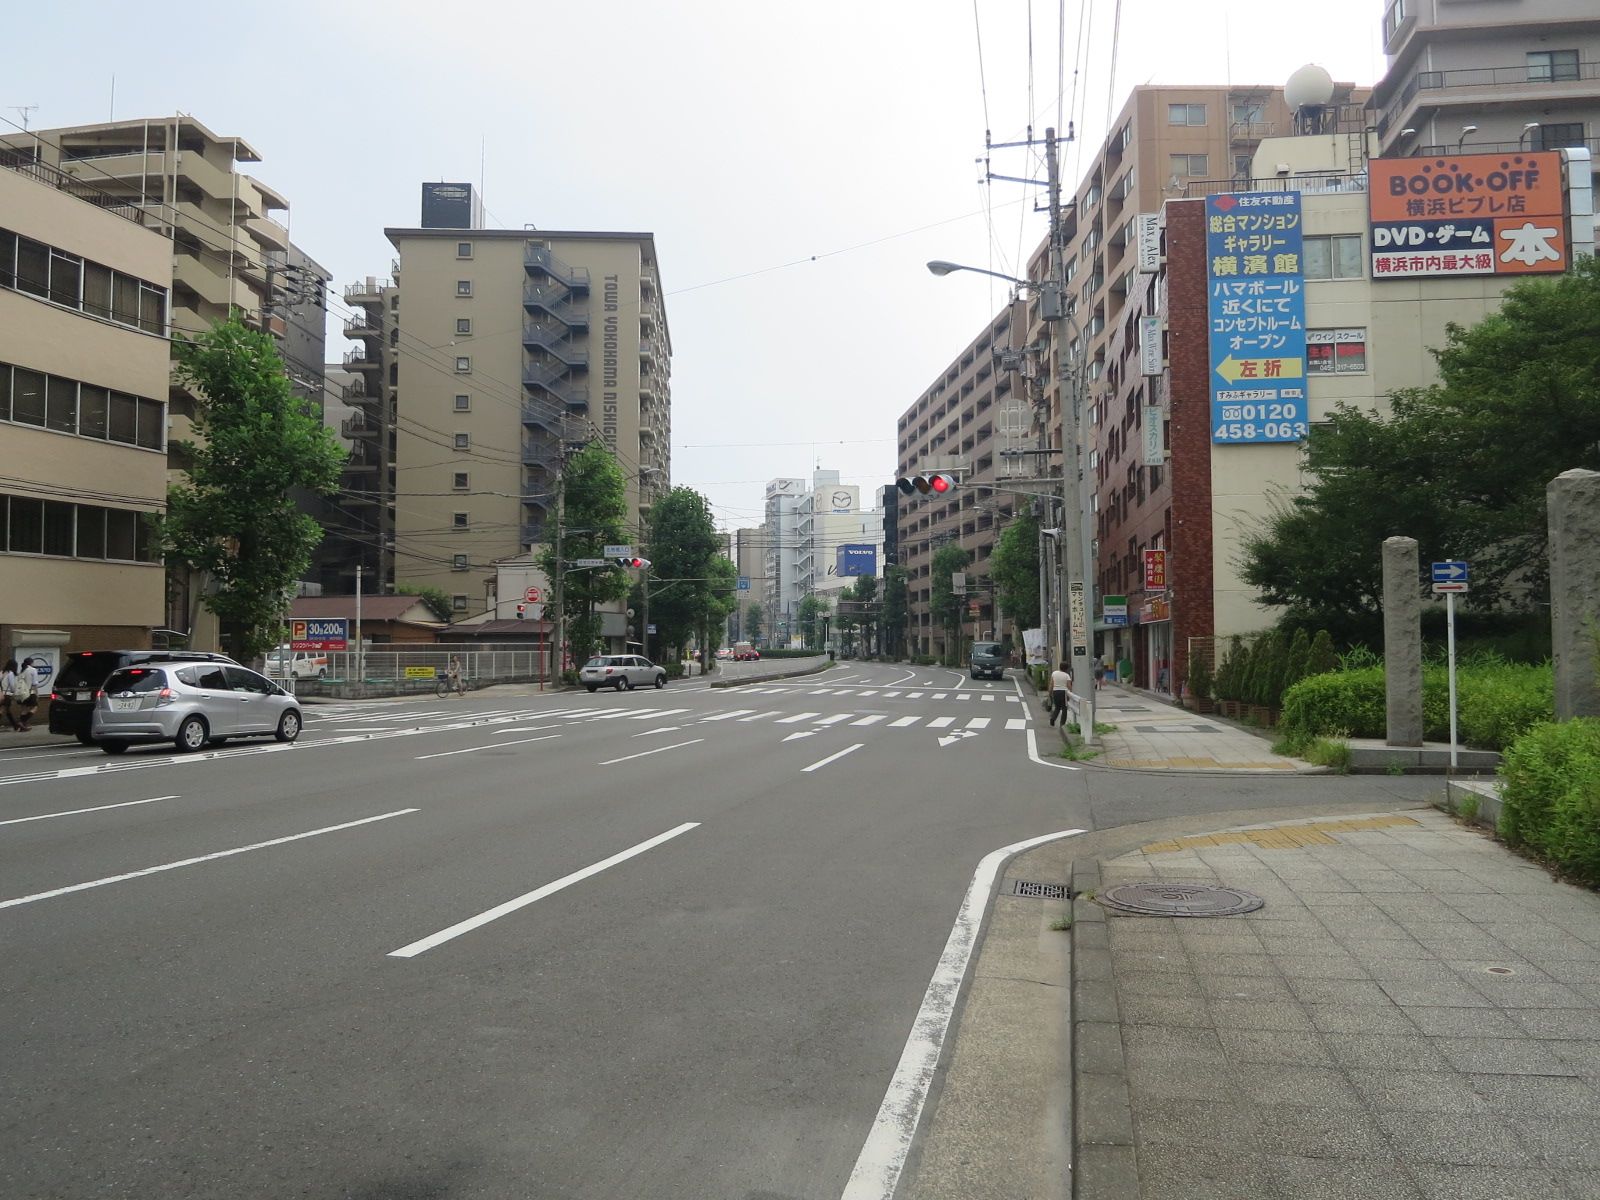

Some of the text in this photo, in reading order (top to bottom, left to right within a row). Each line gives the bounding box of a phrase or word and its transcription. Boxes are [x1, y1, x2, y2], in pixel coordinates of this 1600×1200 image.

[1238, 195, 1295, 207] 住友不動産
[1406, 195, 1526, 216] 横浜ビブレ店
[1146, 217, 1158, 236] Max
[1209, 213, 1299, 233] 総合マンション
[1224, 234, 1286, 253] ギャラリー
[1500, 222, 1560, 266] 本
[1146, 246, 1159, 266] Alex
[1375, 253, 1492, 273] 横浜市内最大級
[604, 274, 618, 312] TOWA
[1213, 280, 1300, 297] ハマボール
[1222, 297, 1291, 315] 近くにて
[1214, 315, 1301, 332] コンセプトルーム
[1229, 333, 1286, 350] オープン
[1315, 332, 1364, 341] ワイン スクール
[603, 316, 618, 388] YOKOHAMA
[1239, 359, 1281, 378] 左折
[1218, 390, 1273, 399] すみふギャラリー
[1242, 403, 1296, 420] 0120
[1214, 422, 1307, 440] 458-063
[295, 622, 306, 636] P
